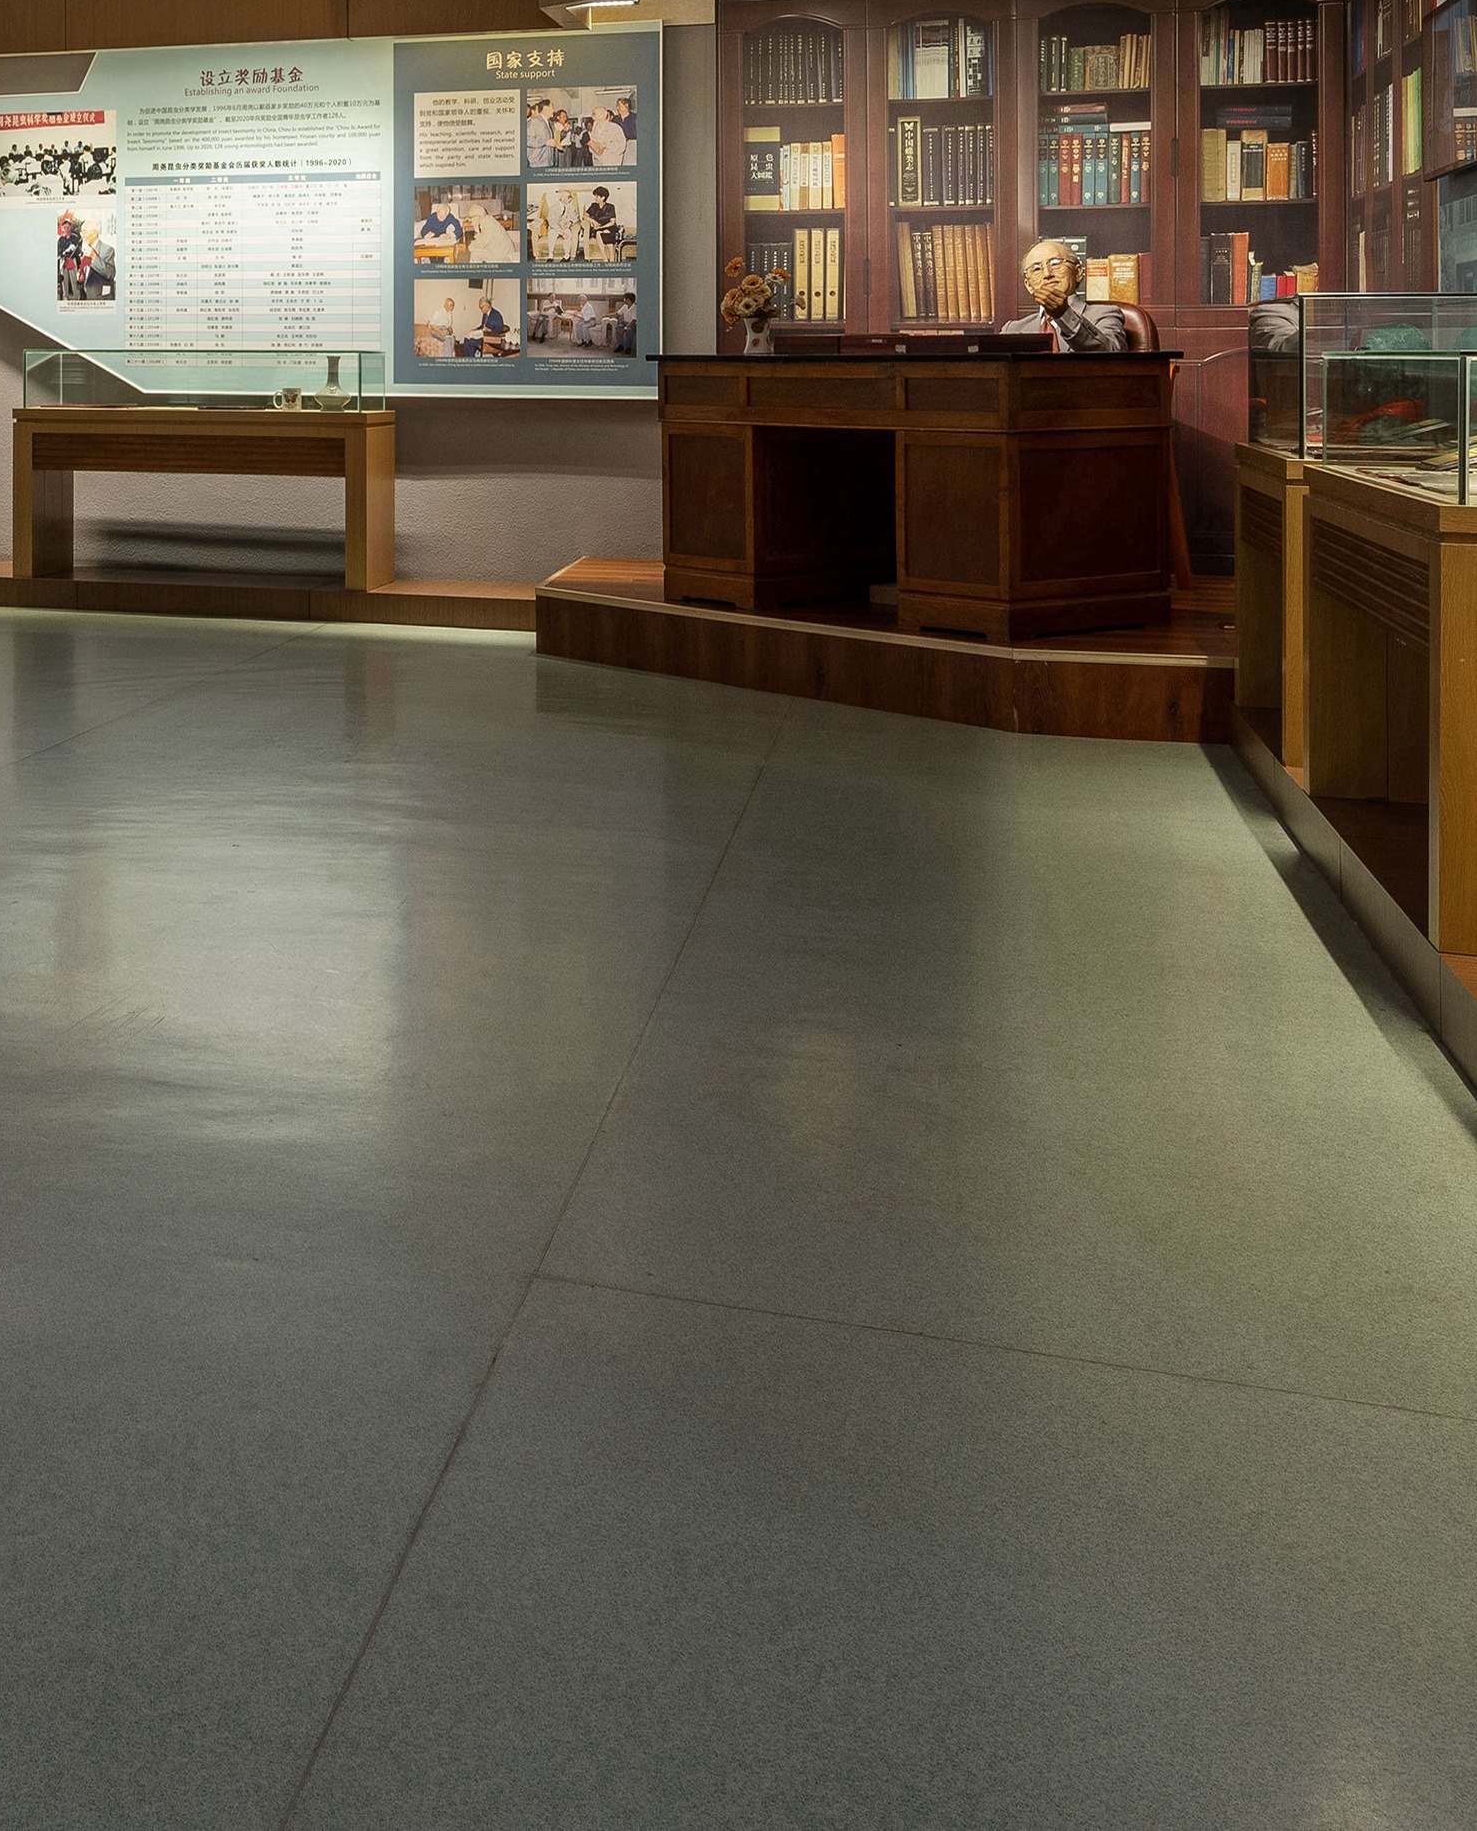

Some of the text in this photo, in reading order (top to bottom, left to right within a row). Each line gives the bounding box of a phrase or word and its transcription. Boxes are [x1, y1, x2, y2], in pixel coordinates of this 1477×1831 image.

[486, 49, 565, 70] 国家支持
[200, 67, 305, 87] 设立奖励基金
[496, 69, 556, 81] State support
[185, 84, 319, 97] Establishing an award Foundation
